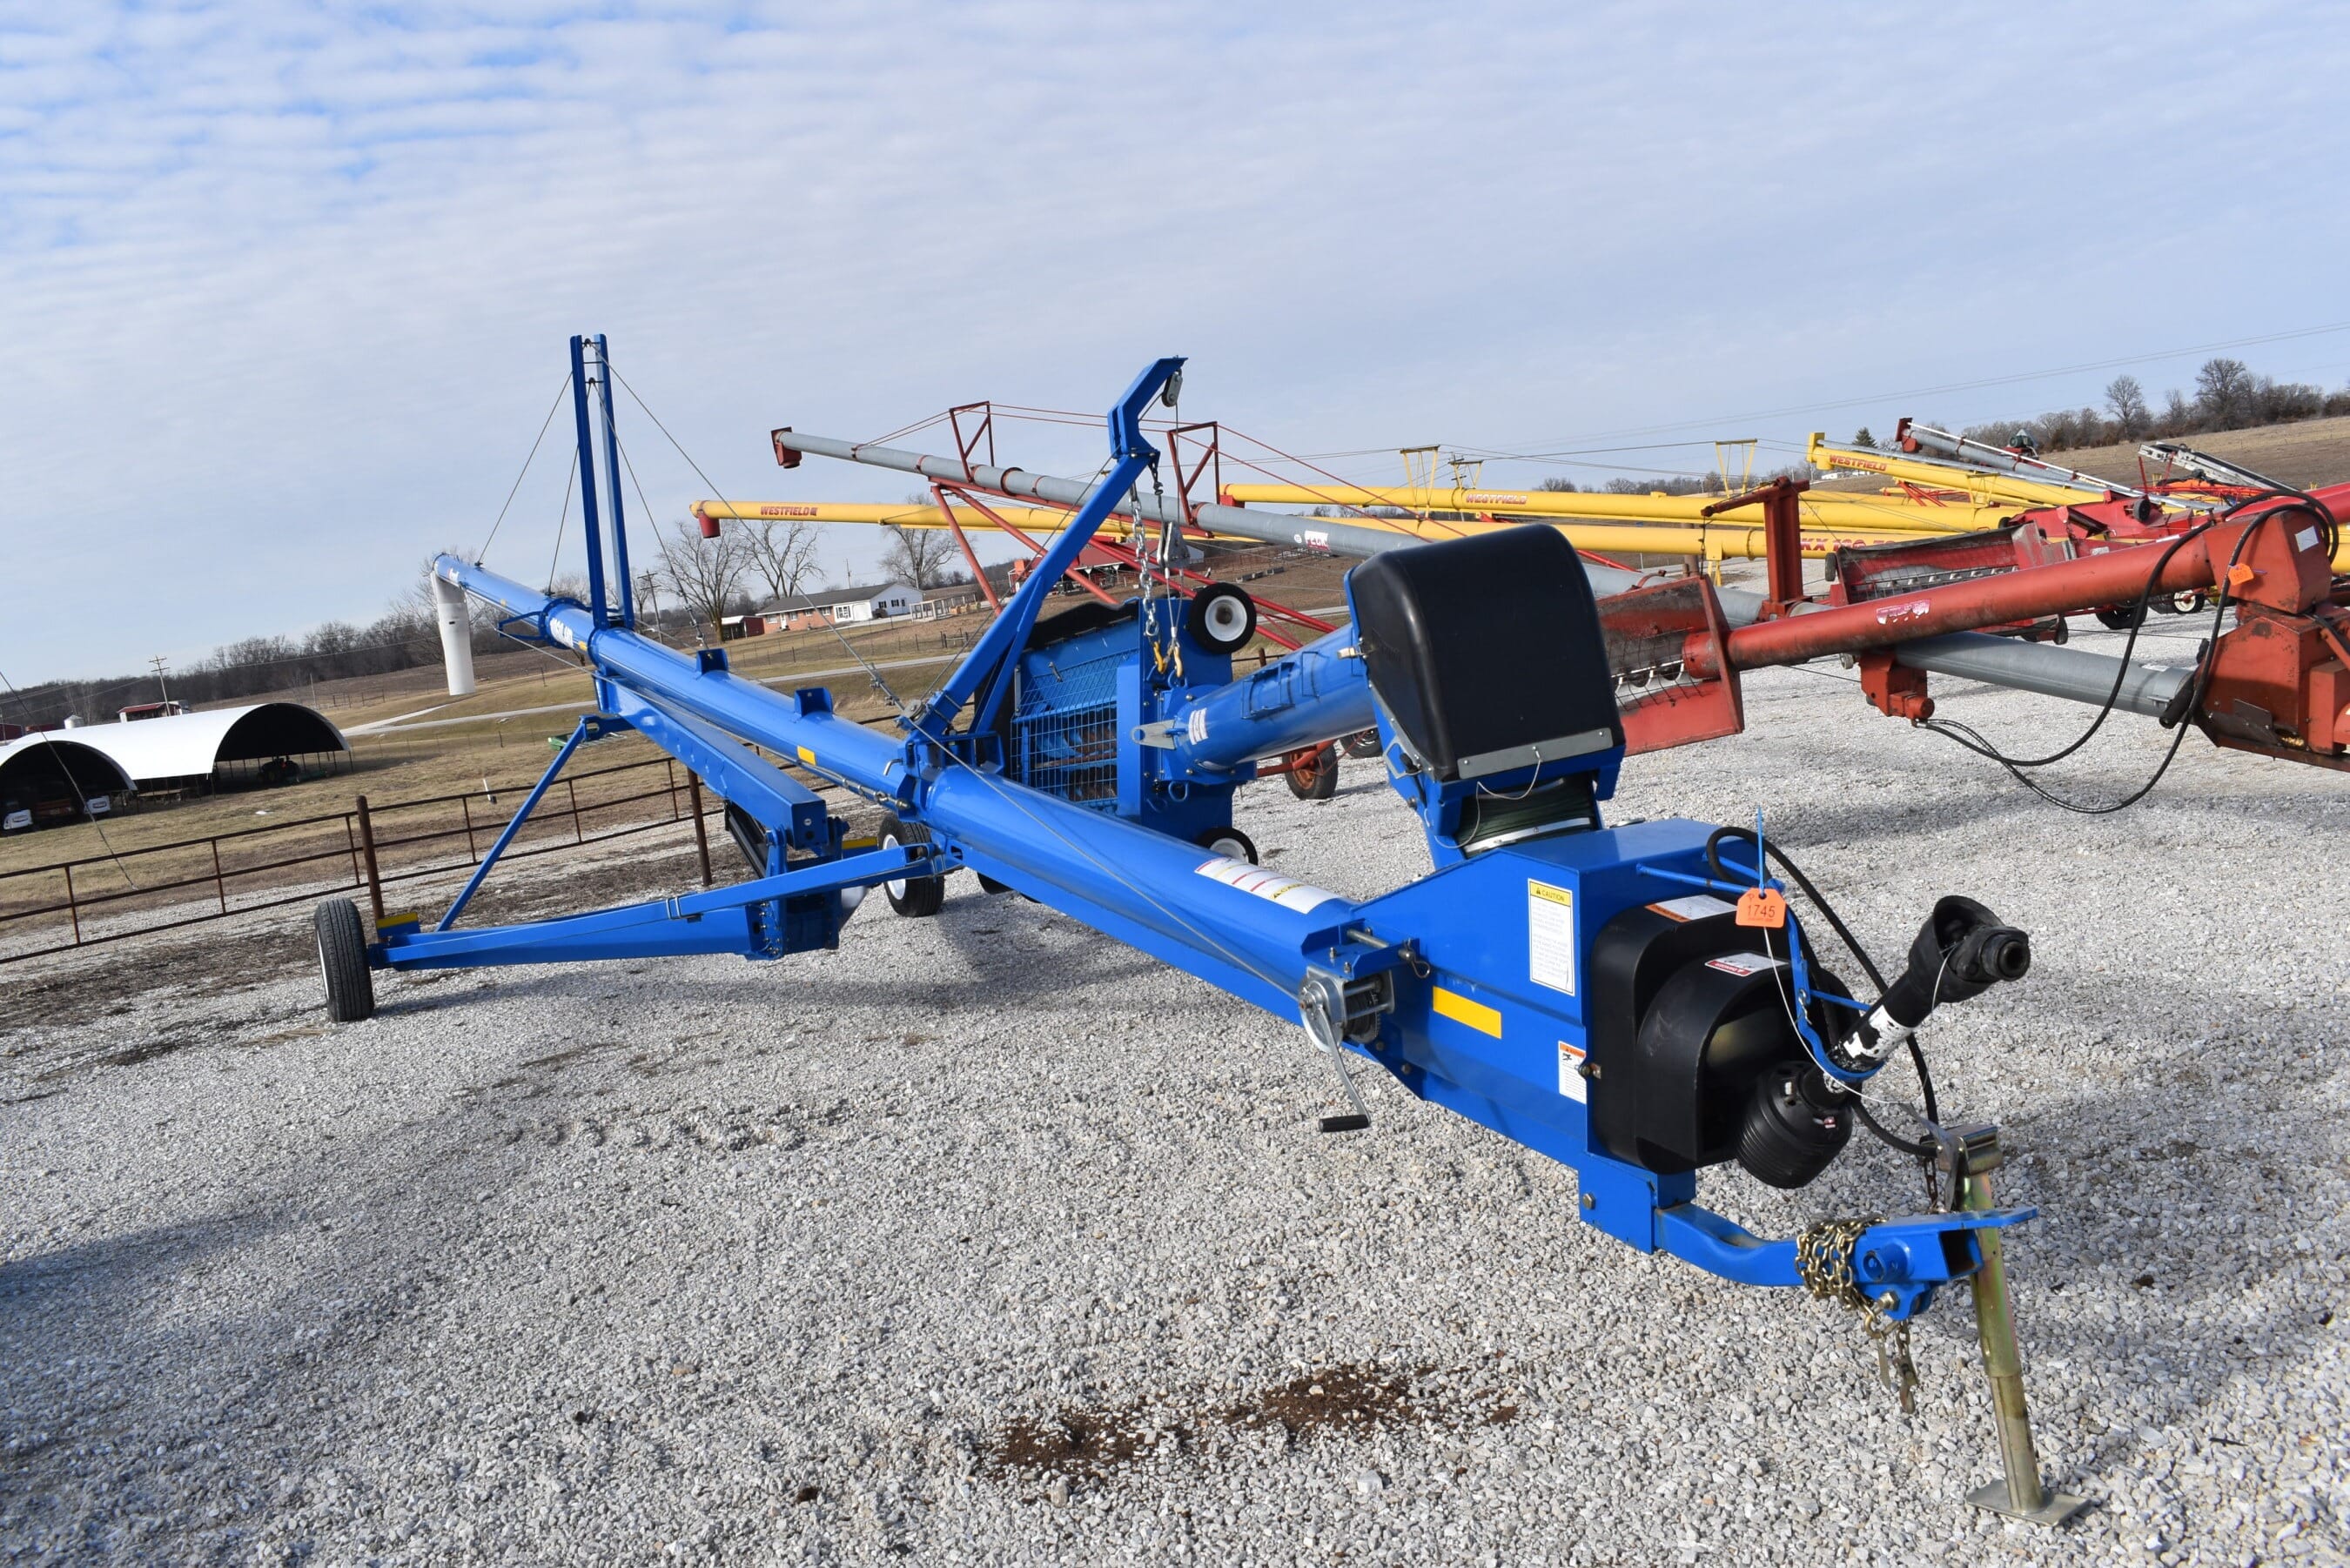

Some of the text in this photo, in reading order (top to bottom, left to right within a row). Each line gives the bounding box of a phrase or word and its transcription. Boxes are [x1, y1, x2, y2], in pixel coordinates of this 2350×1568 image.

[1830, 454, 1887, 471] WESTFIELD
[1467, 493, 1528, 505] WESTFIELD
[760, 506, 809, 516] WESTFIELD
[1541, 889, 1565, 902] CAUTION
[1748, 904, 1776, 918] 1745
